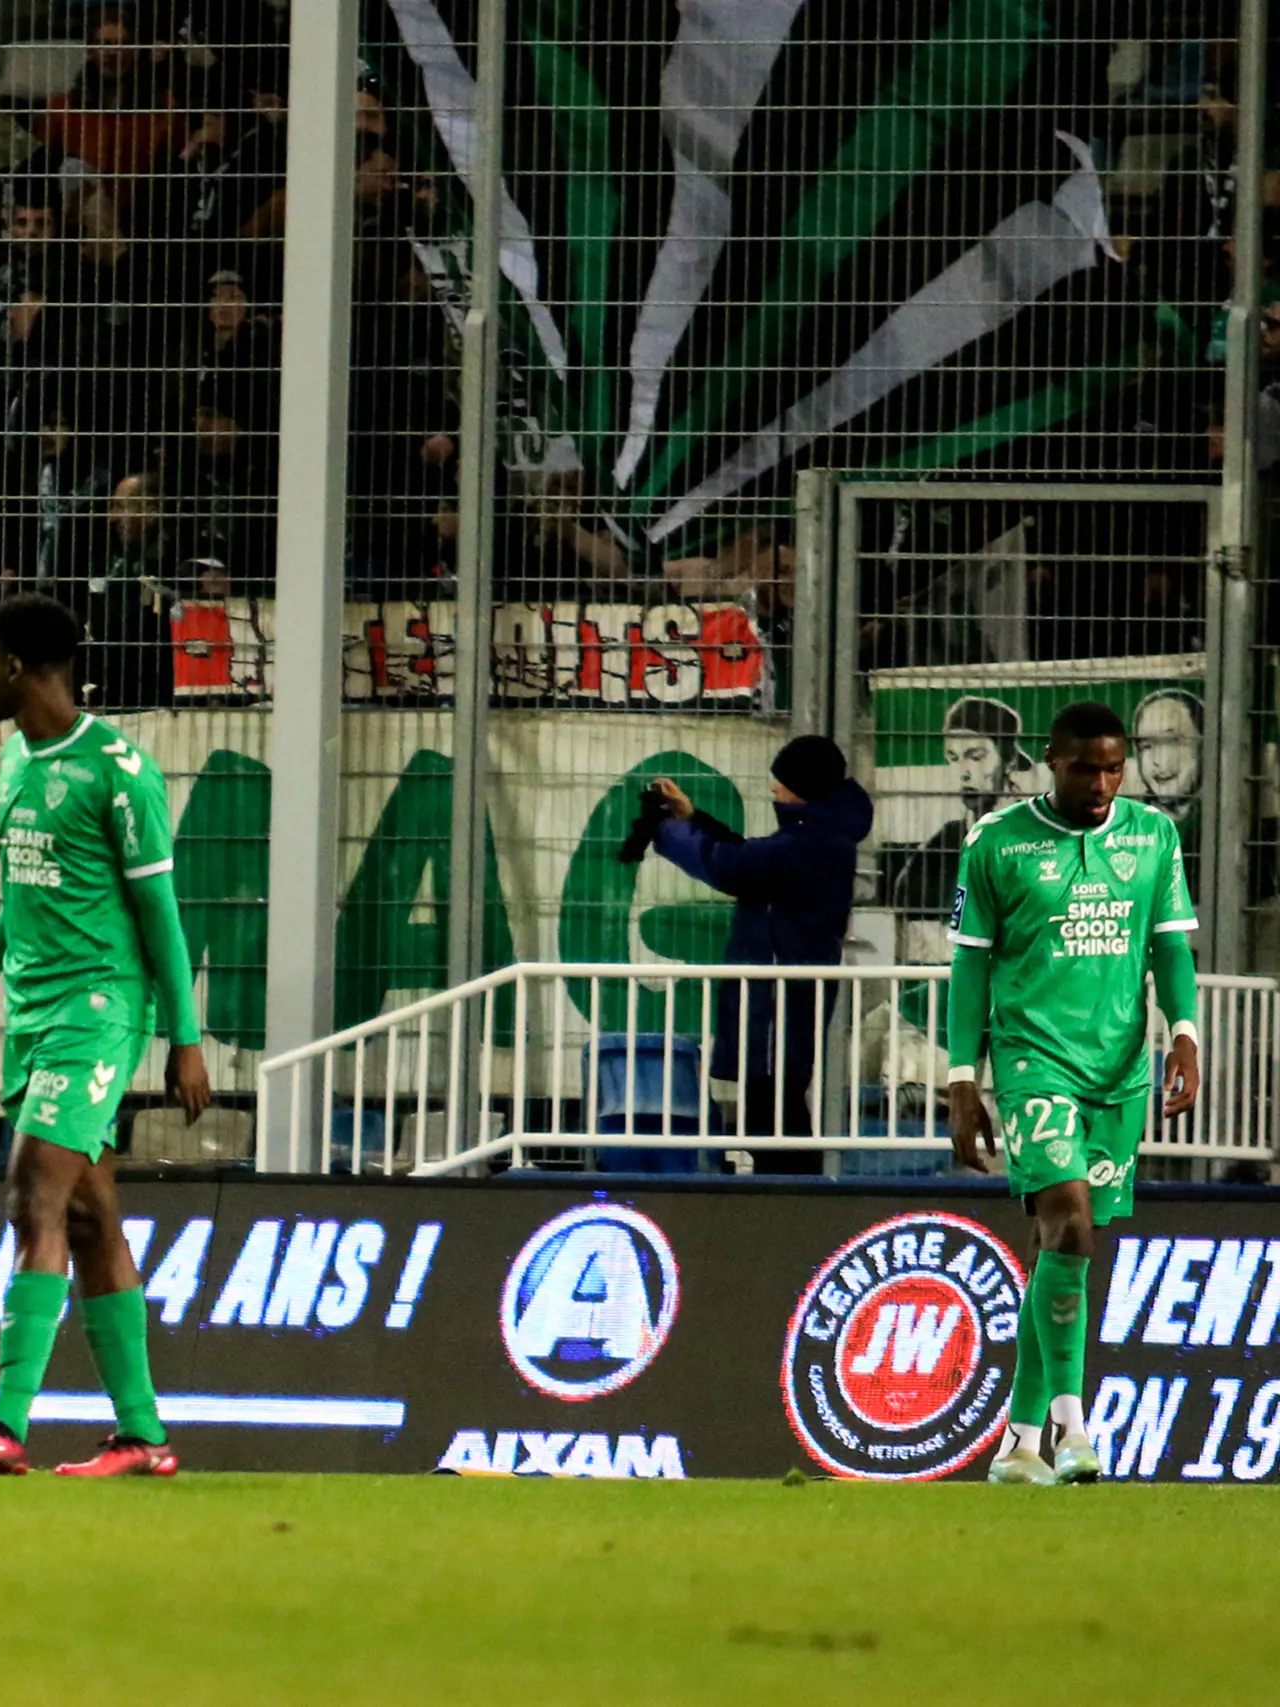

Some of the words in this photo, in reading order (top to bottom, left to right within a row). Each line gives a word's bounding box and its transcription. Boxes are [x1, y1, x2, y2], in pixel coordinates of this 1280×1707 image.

[1060, 920, 1119, 938] GOOD
[1068, 901, 1133, 920] SMART
[1025, 1095, 1078, 1142] 27
[209, 1219, 386, 1328] ANS
[803, 1231, 946, 1342] CENTRE
[946, 1243, 1020, 1343] AUTO
[850, 1303, 962, 1375] JW
[438, 1430, 687, 1480] AIXAM
